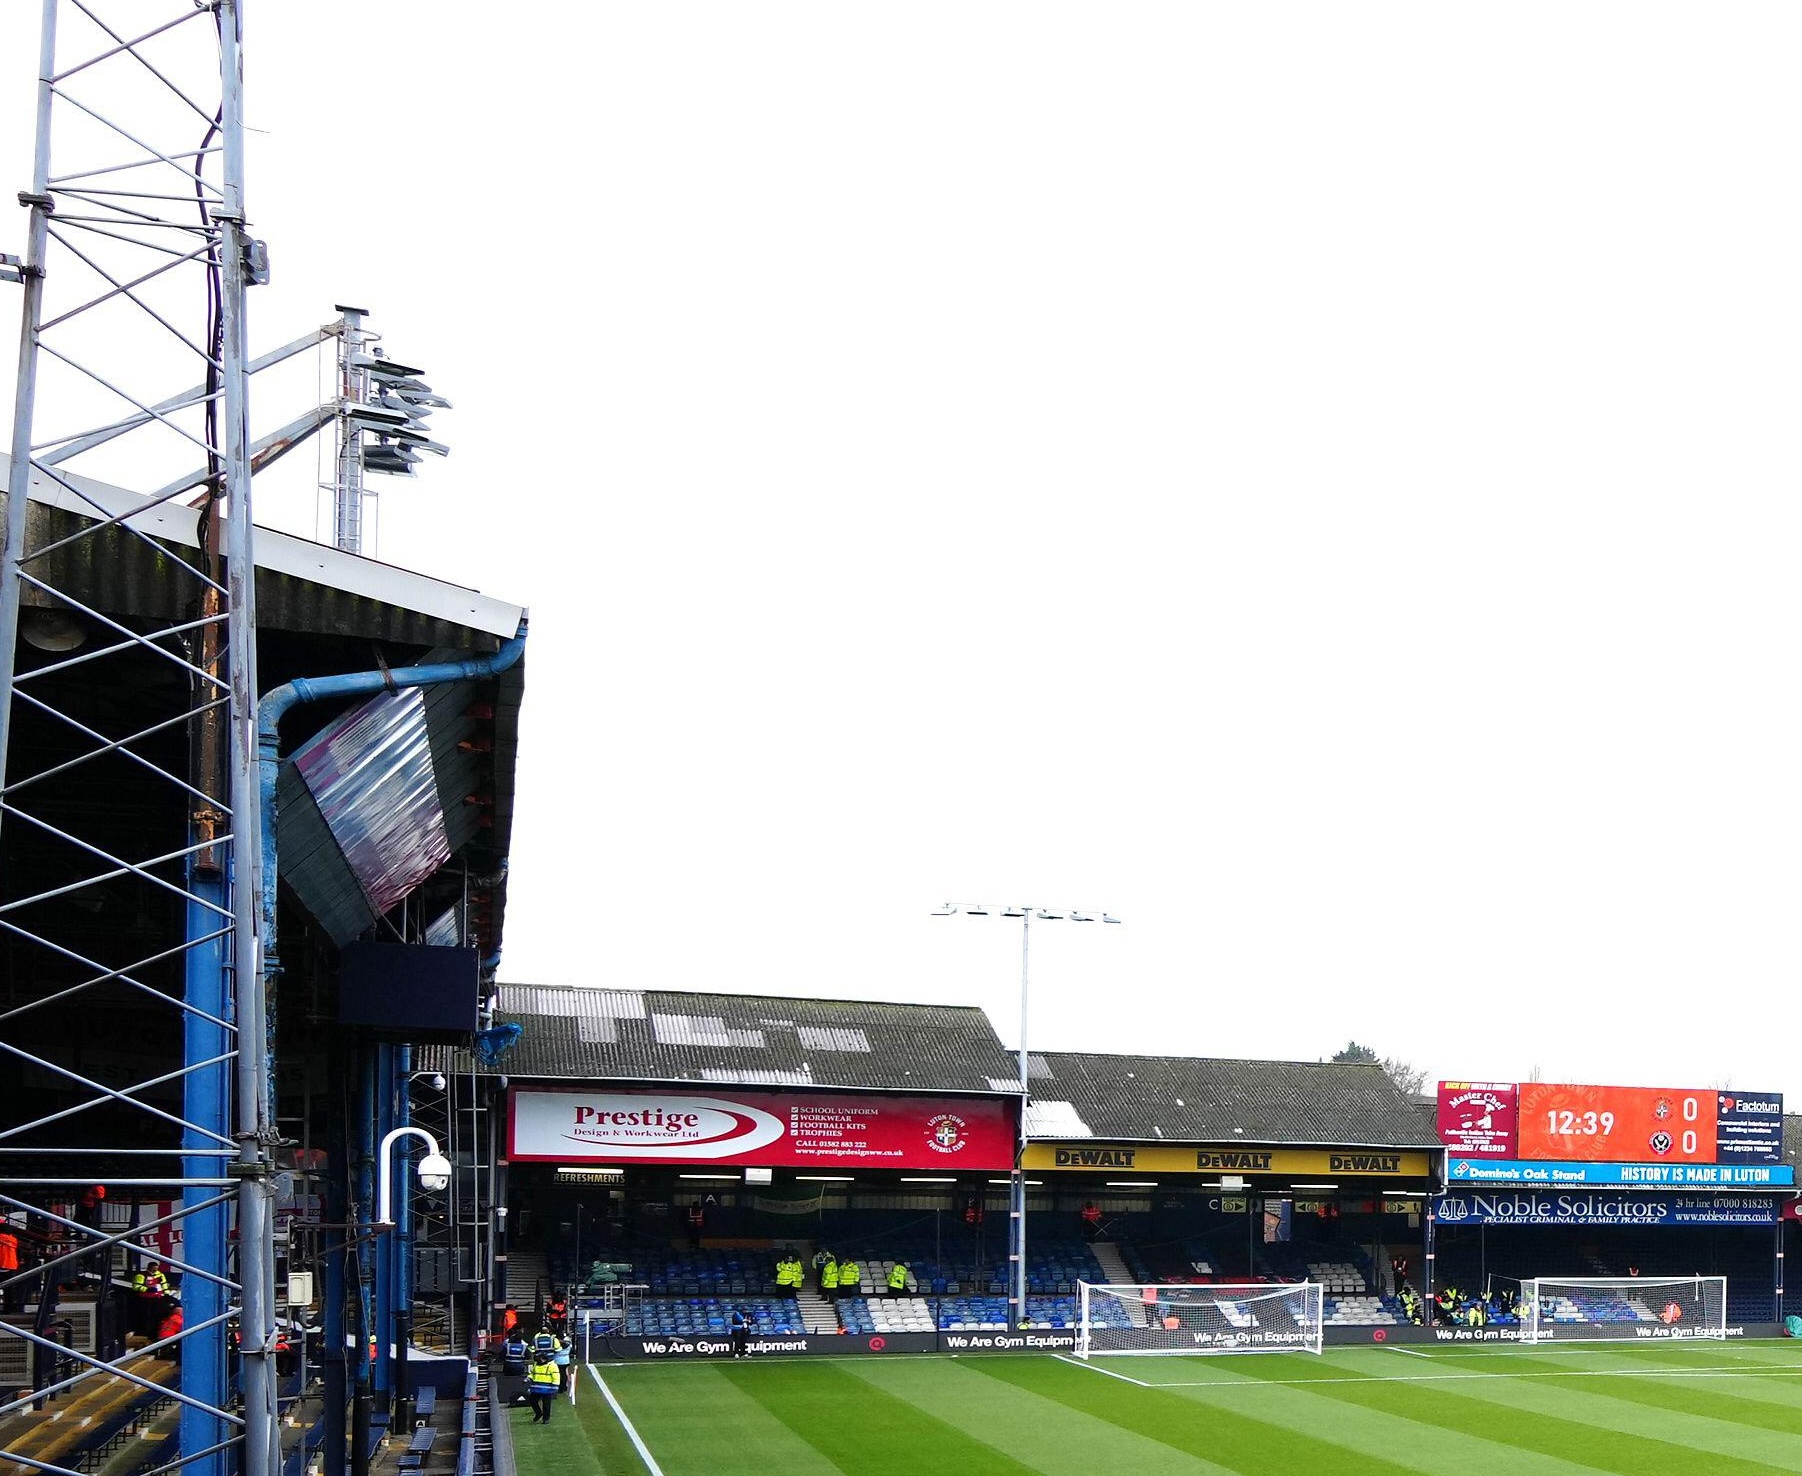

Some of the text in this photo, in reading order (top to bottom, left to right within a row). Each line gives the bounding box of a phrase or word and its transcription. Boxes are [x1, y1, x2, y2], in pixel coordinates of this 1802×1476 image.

[1449, 1092, 1506, 1111] Master Chef
[1736, 1100, 1780, 1112] Factotum
[1683, 1098, 1697, 1121] 0
[574, 1107, 699, 1132] Prestige
[927, 1114, 966, 1127] LUTON TOWN
[1548, 1110, 1614, 1135] 12:39
[574, 1128, 609, 1137] Design
[926, 1140, 952, 1153] FOOTBALL
[1682, 1130, 1697, 1154] 0
[554, 1173, 625, 1184] REFRESHMENTS
[1470, 1168, 1586, 1181] Domino's Oak Stand
[1621, 1167, 1770, 1182] HISTORY IS MADE IN LUTON
[1209, 1200, 1218, 1210] C
[1471, 1194, 1668, 1218] Noble Solicitors
[1697, 1199, 1711, 1208] line
[1714, 1199, 1740, 1208] 07000
[1742, 1199, 1773, 1209] 818283
[1480, 1216, 1527, 1224] PECIALIST
[1676, 1211, 1773, 1222] www.noblesolicitors.co.uk
[1436, 1330, 1453, 1340] We
[1455, 1330, 1472, 1339] Are
[1474, 1330, 1499, 1340] Gym
[1636, 1327, 1652, 1337] We
[1653, 1327, 1669, 1336] Are
[1671, 1327, 1693, 1337] Gym
[643, 1342, 666, 1354] We
[668, 1342, 694, 1353] Are
[696, 1341, 730, 1354] Gym
[947, 1336, 1024, 1349] We Are Gym
